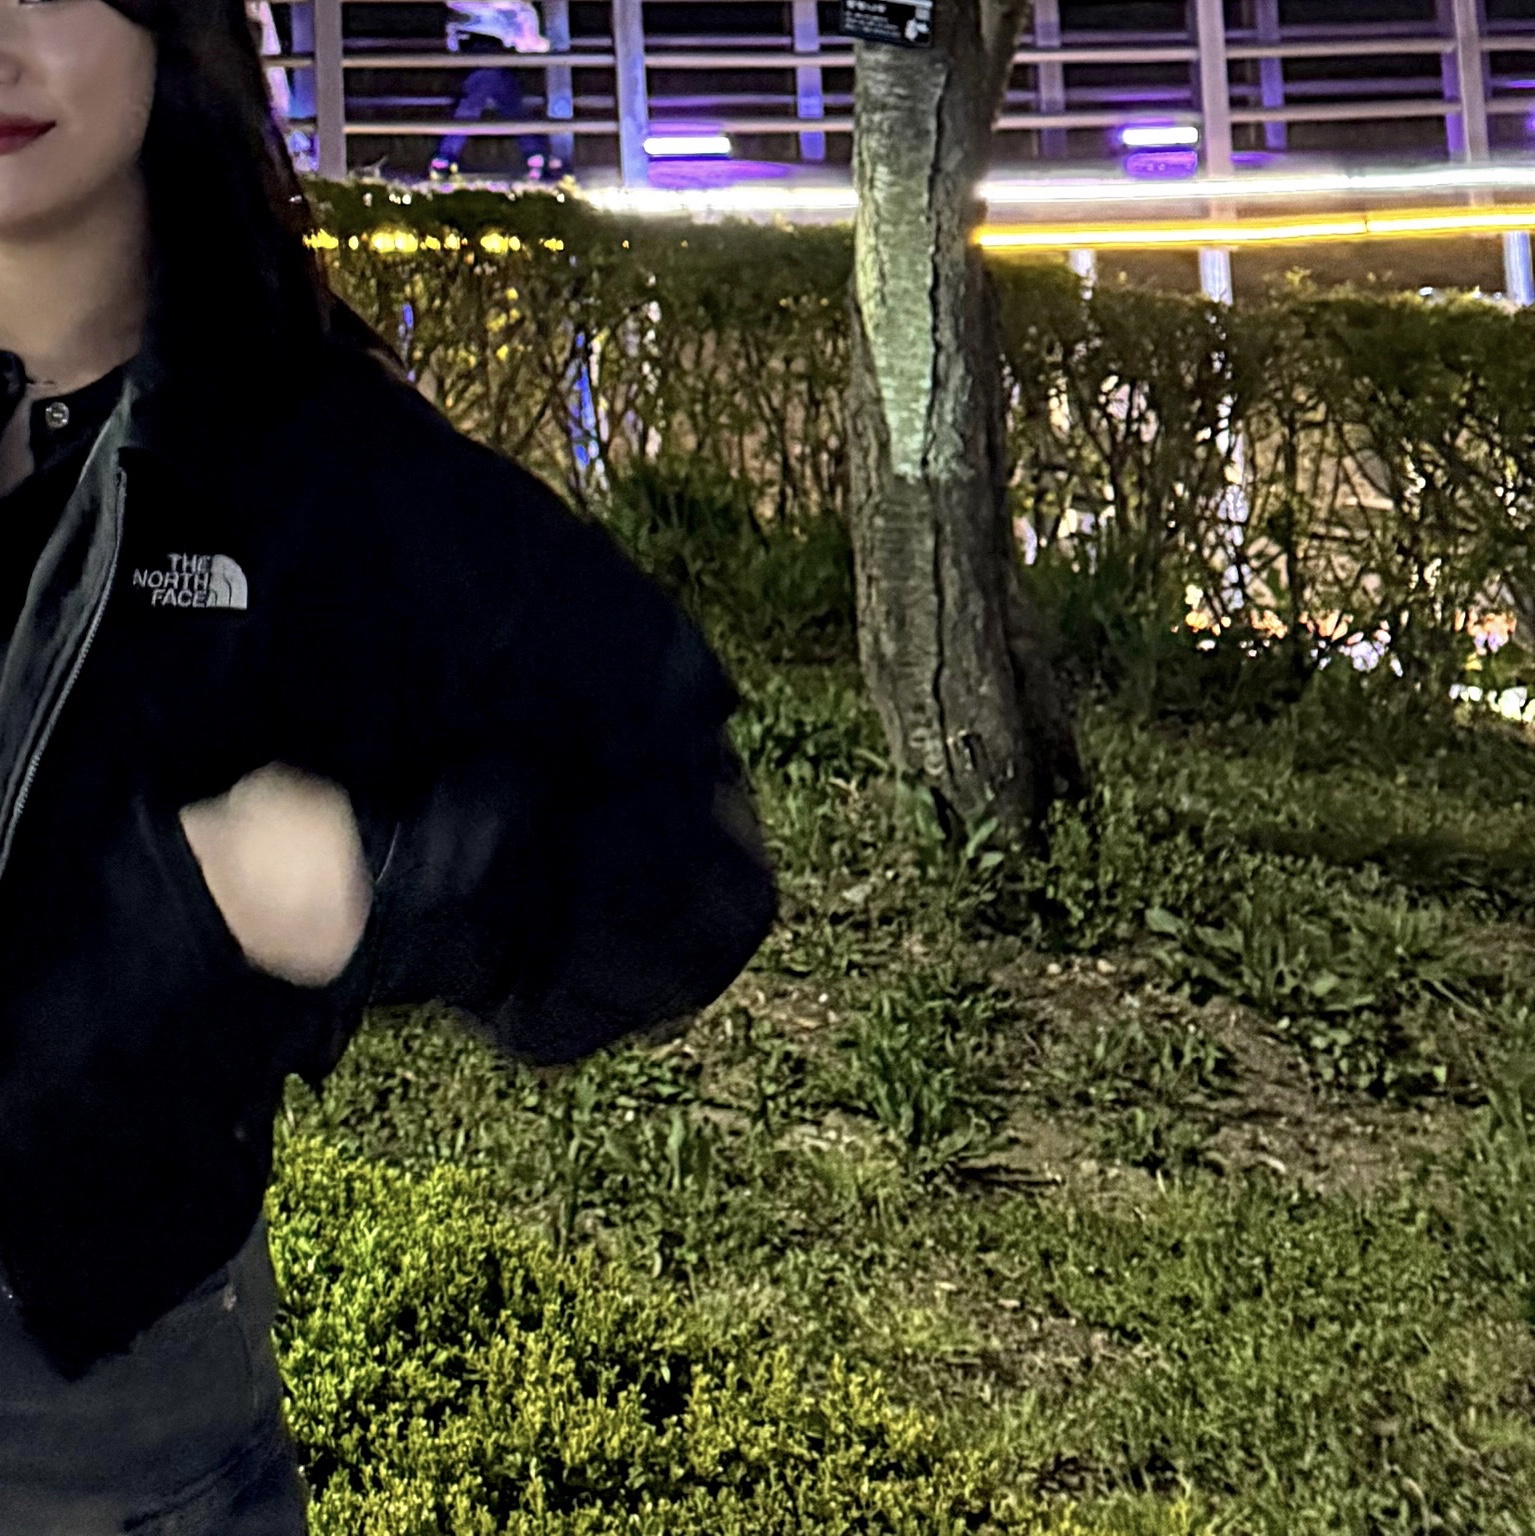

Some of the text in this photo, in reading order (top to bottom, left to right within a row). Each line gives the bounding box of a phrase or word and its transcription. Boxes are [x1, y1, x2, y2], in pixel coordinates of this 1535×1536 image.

[167, 552, 211, 572] THE
[132, 568, 210, 593] NORTH
[151, 588, 205, 607] FACE
